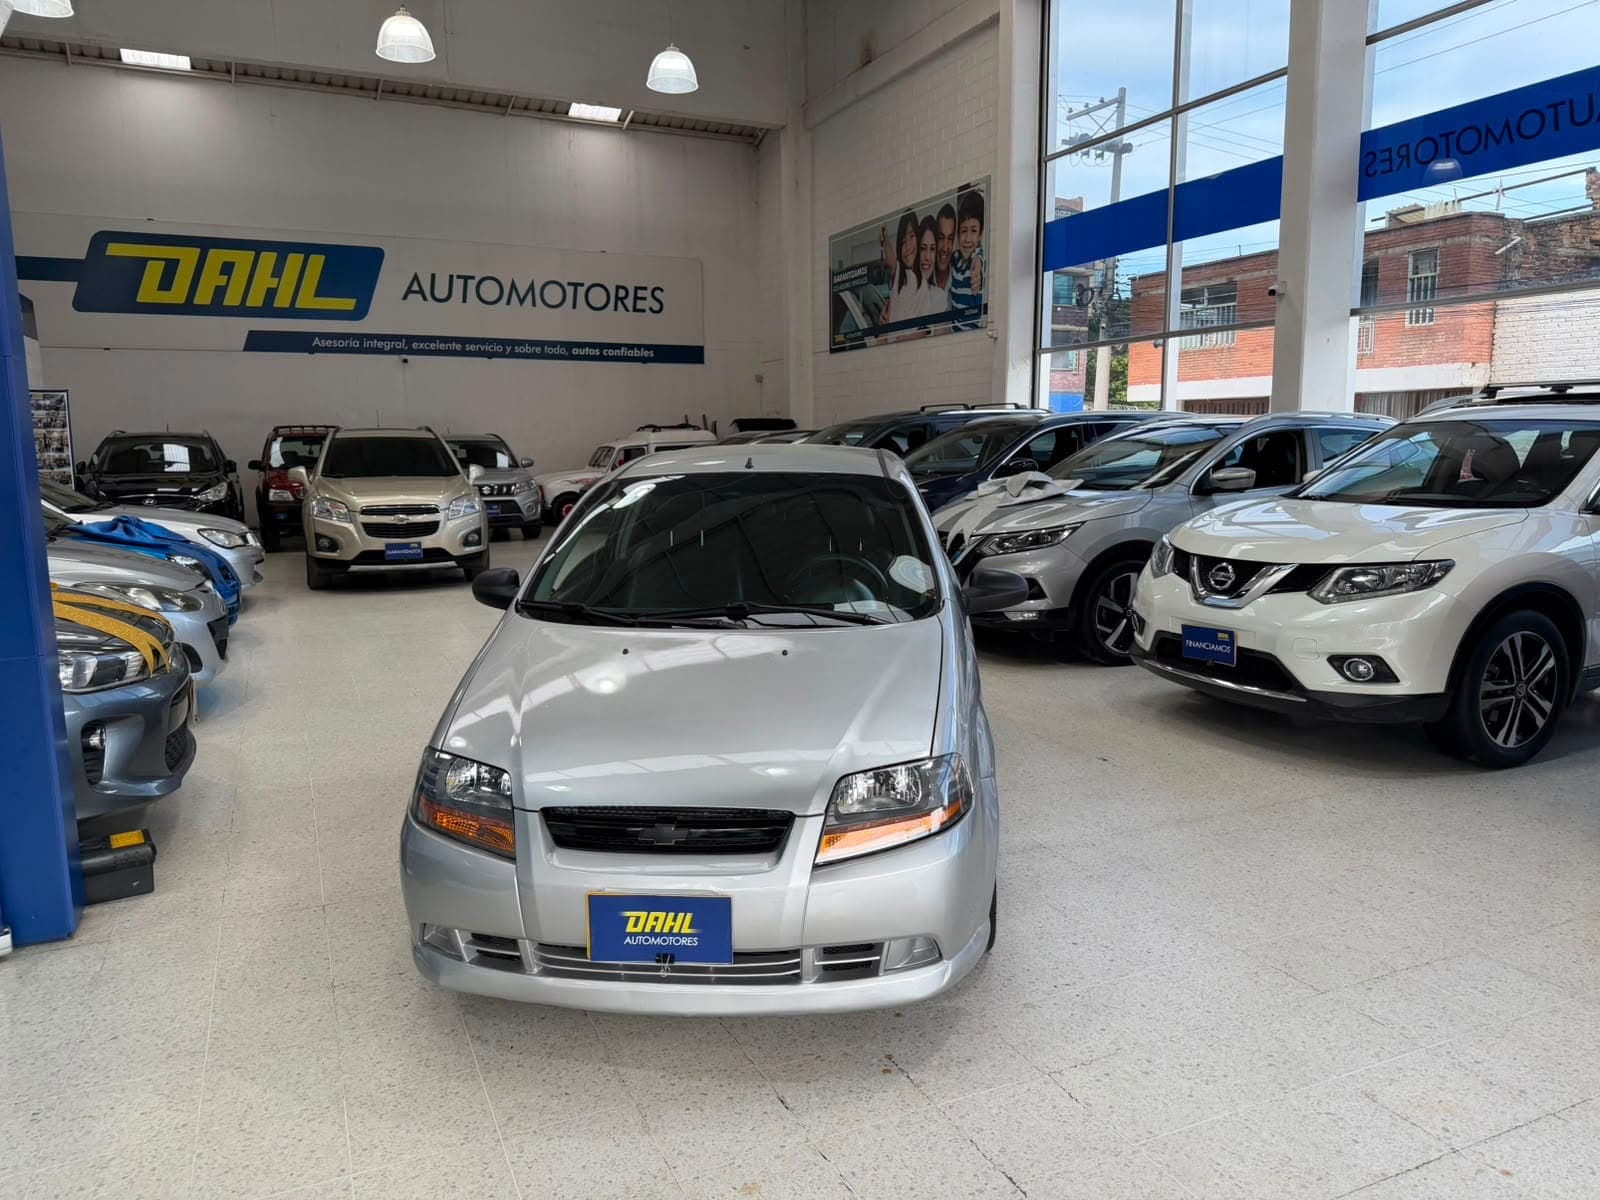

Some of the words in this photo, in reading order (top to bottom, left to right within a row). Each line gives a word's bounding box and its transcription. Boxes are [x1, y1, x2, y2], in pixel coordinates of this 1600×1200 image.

[105, 242, 356, 310] DAHL
[401, 272, 665, 314] AUTOMOTORES
[363, 337, 408, 351] integral,
[412, 339, 462, 351] excelente
[464, 341, 503, 353] servicio
[505, 345, 512, 355] y
[514, 343, 542, 354] sobre
[544, 345, 569, 356] todo,
[572, 346, 600, 356] autos
[602, 347, 655, 358] confiables
[1185, 639, 1231, 654] FINANCIAMOS
[619, 911, 700, 934] DAHL
[623, 936, 699, 946] AUTOMOTORES
